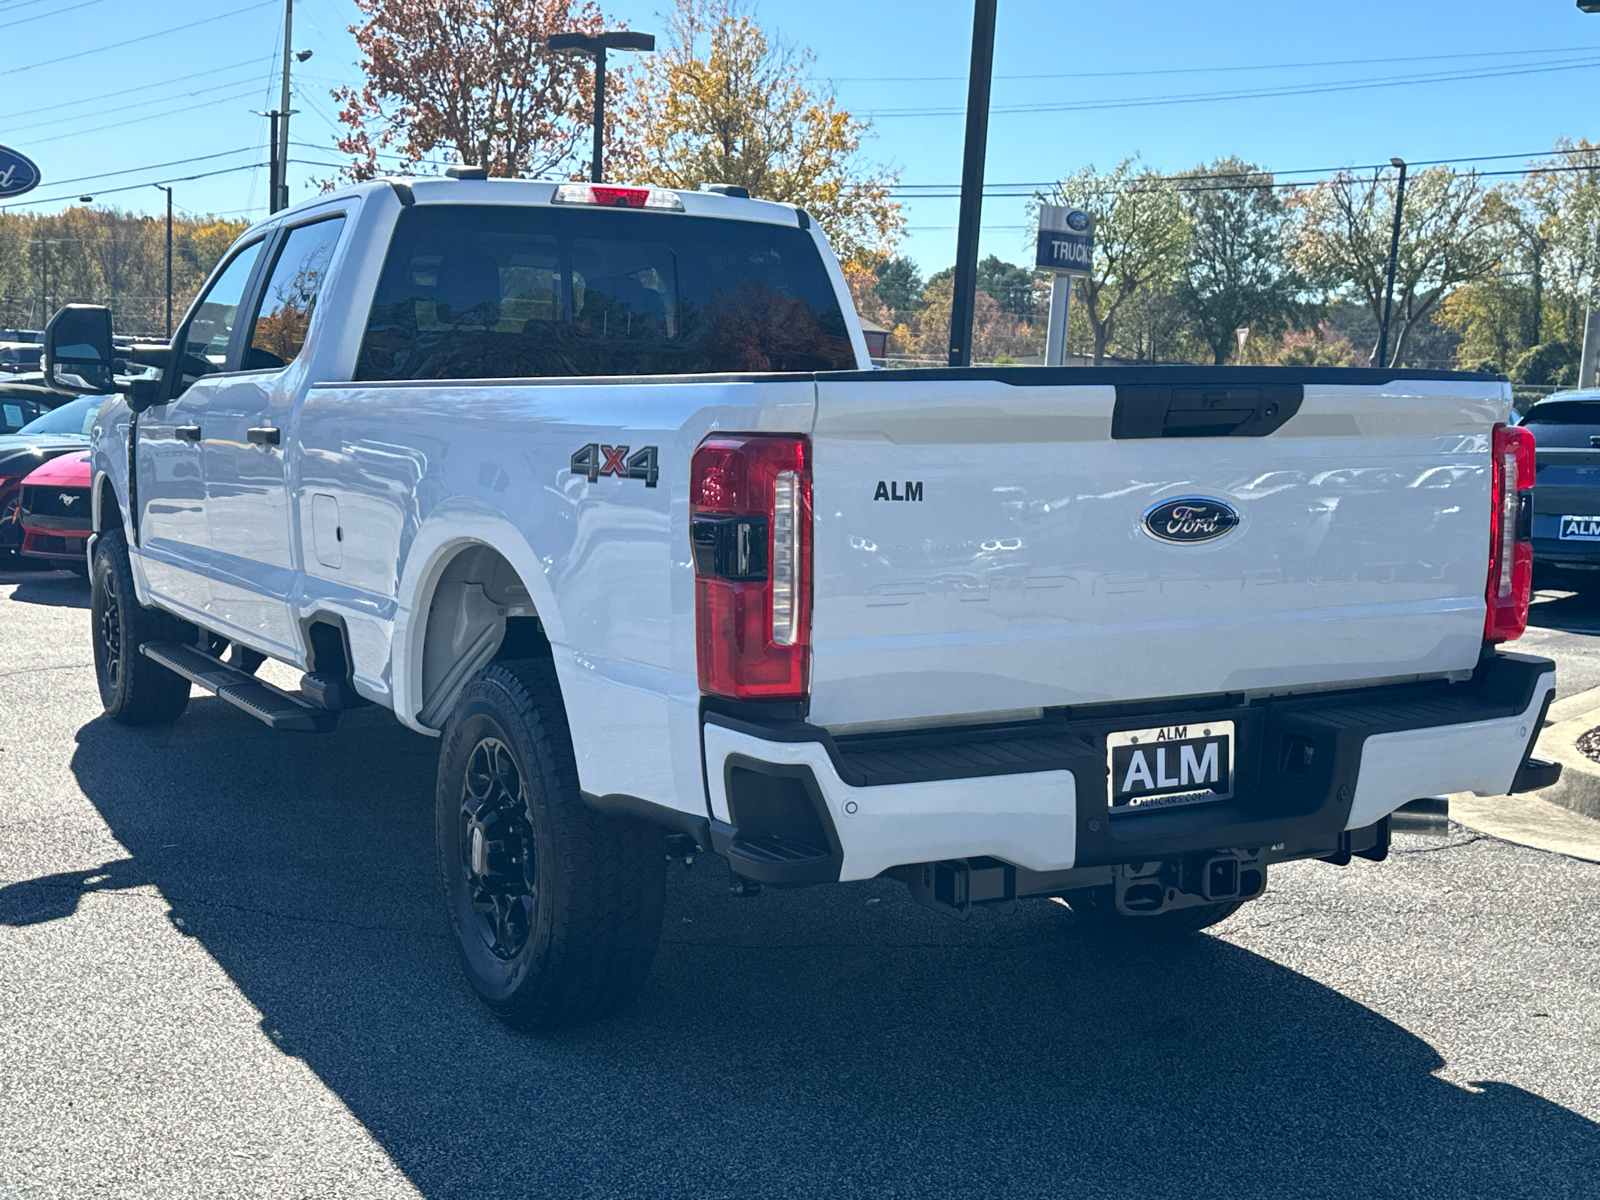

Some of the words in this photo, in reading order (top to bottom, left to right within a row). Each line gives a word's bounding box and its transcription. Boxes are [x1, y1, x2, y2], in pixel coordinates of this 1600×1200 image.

[1052, 240, 1092, 264] TRUCKS
[873, 480, 923, 501] ALM
[1167, 506, 1219, 534] Ford
[1157, 726, 1187, 742] ALM
[1121, 742, 1219, 792] ALM
